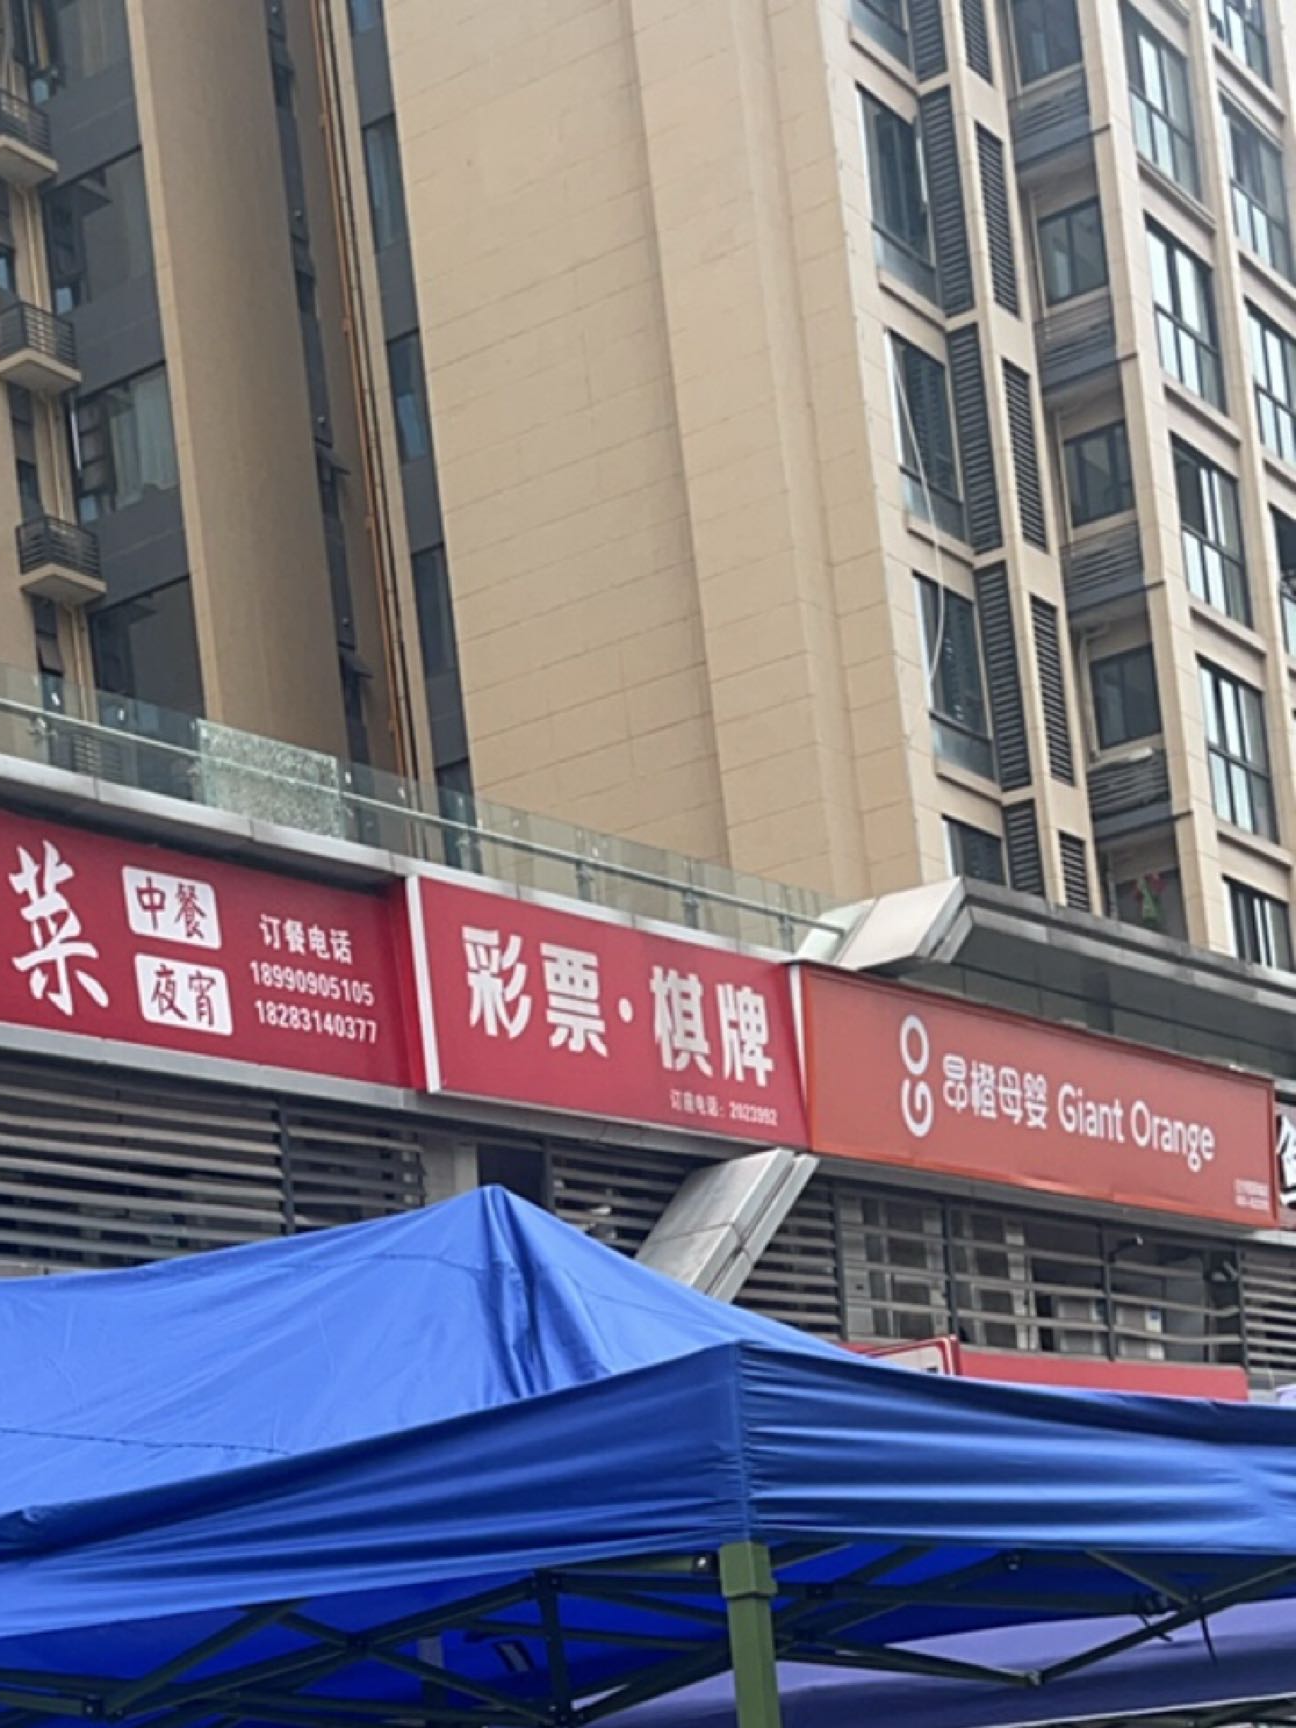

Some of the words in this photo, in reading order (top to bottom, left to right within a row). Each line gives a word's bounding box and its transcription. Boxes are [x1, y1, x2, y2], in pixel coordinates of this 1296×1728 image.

[136, 876, 207, 940] 中餐
[259, 913, 353, 965] 订餐电话
[151, 963, 217, 1027] 夜宵
[250, 960, 375, 1007] 18990905105
[255, 1000, 377, 1044] 18283140377
[1058, 1084, 1125, 1144] Giant
[1130, 1100, 1215, 1173] Orange
